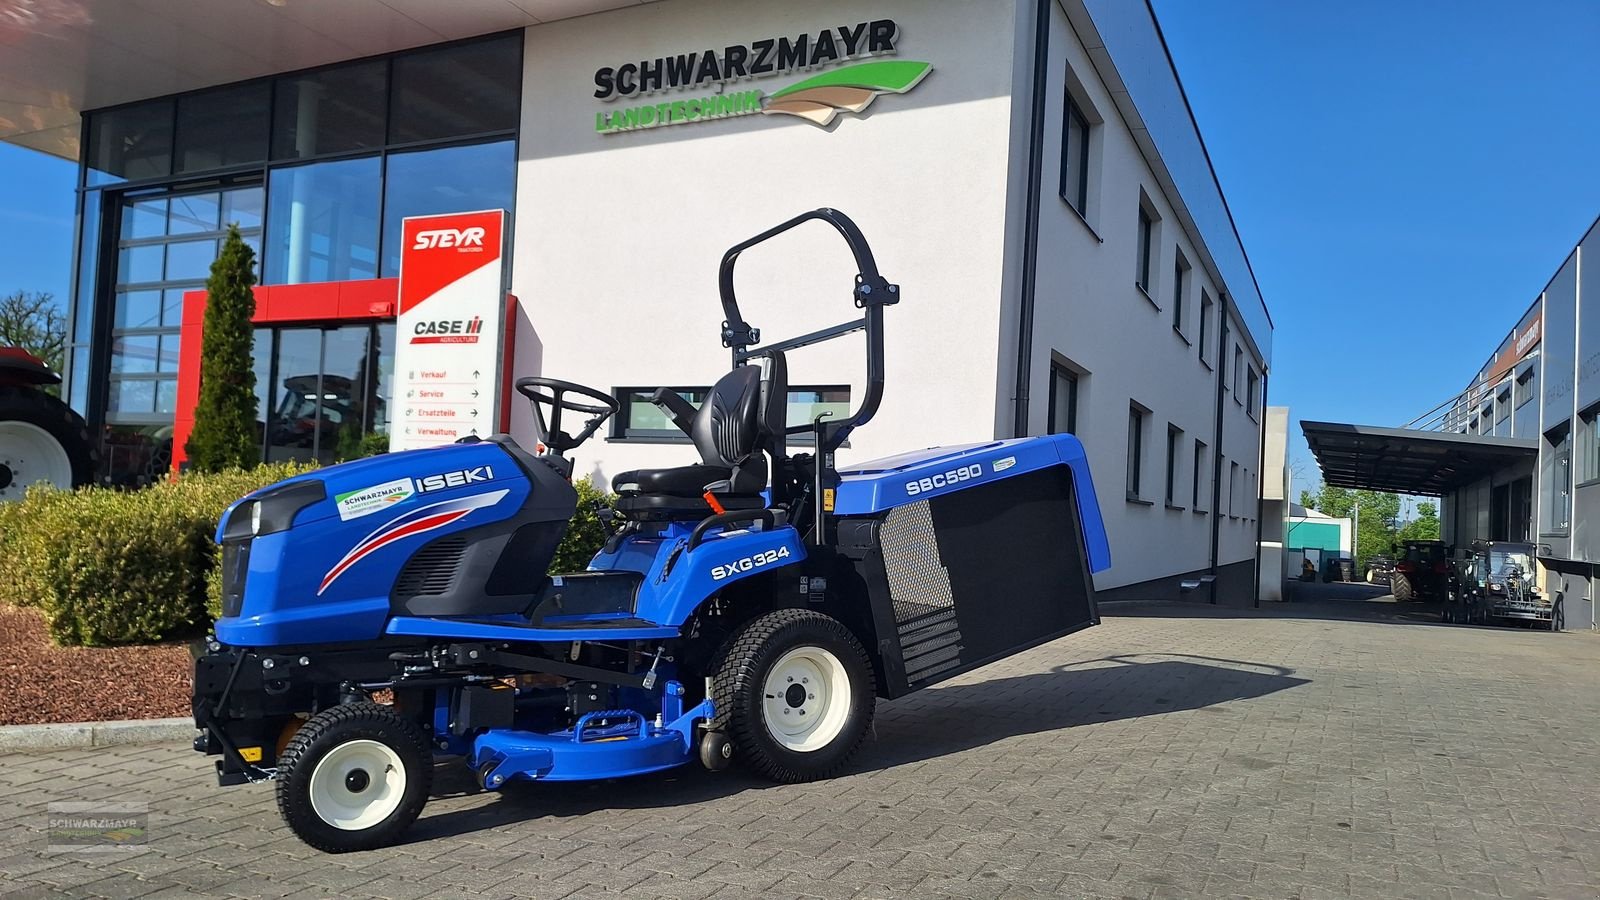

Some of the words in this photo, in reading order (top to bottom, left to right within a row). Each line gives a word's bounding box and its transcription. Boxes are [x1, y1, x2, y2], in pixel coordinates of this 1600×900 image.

[594, 19, 897, 98] SCHWARZMAYR
[595, 89, 762, 132] LANDTECHNIK
[413, 227, 485, 250] STEYR
[414, 320, 463, 335] CASE
[418, 409, 456, 417] Ersatzteile
[417, 428, 457, 437] Verwaltung
[415, 466, 494, 493] ISEKI
[906, 463, 982, 496] SBC590
[344, 486, 403, 506] SCHWARZMAYR
[711, 546, 790, 580] SXG324
